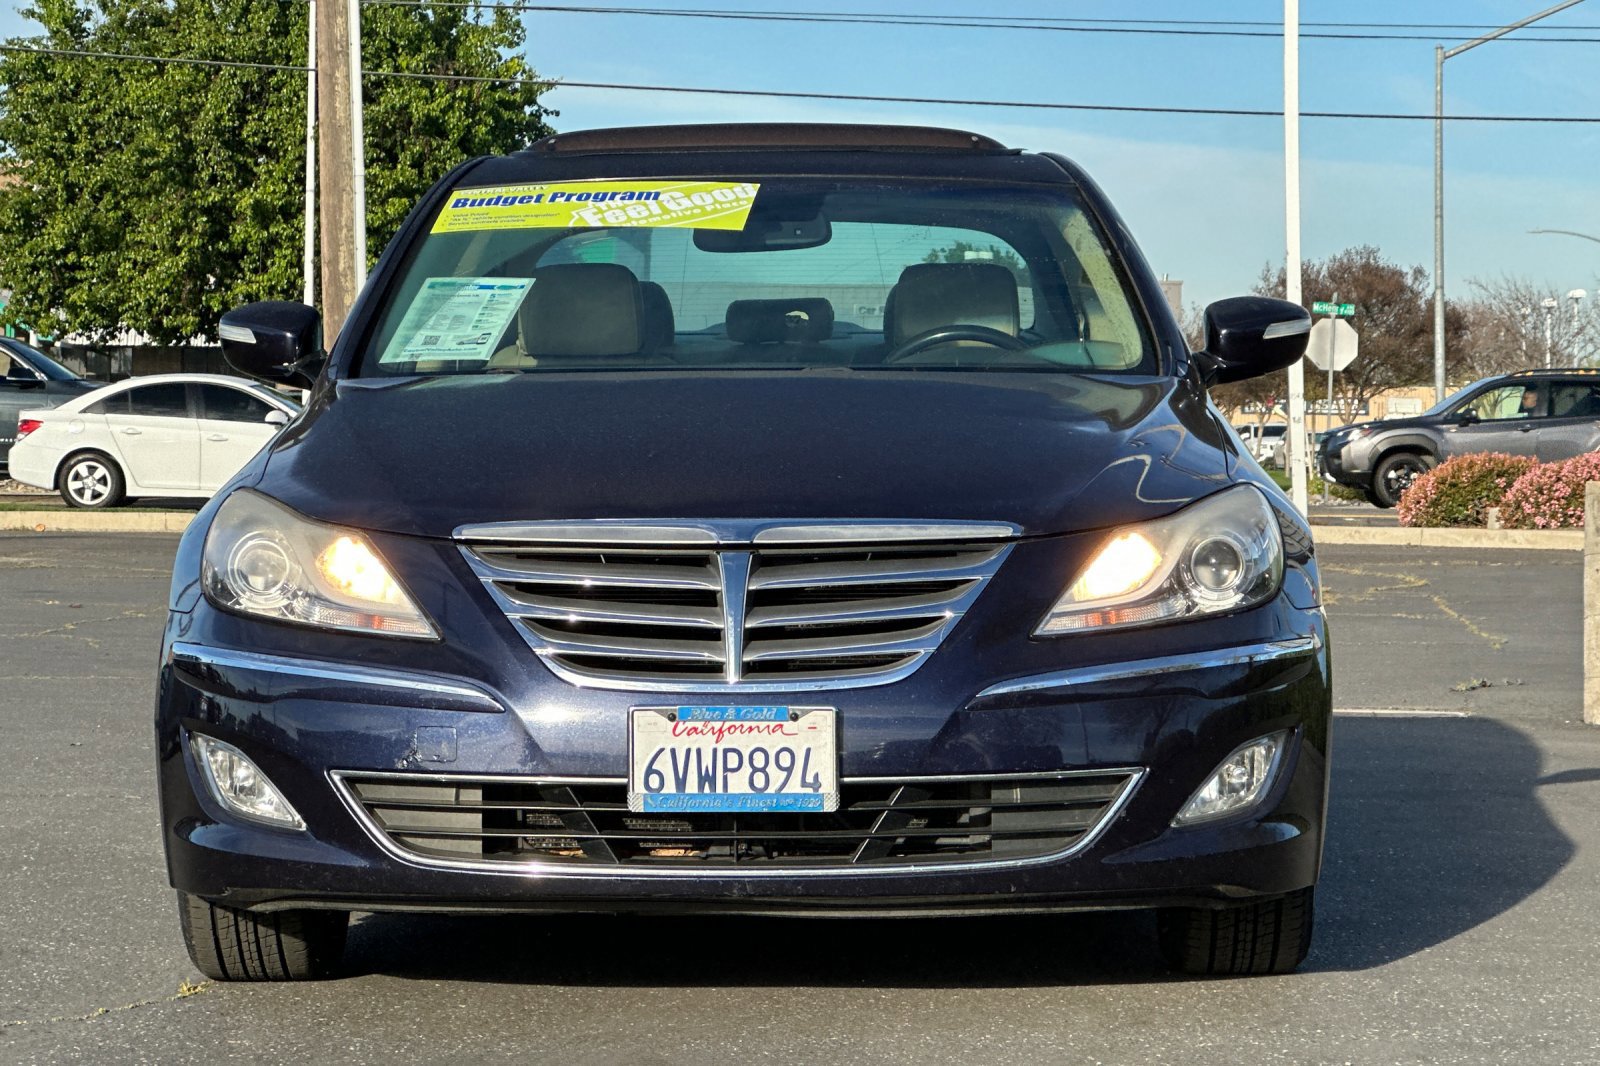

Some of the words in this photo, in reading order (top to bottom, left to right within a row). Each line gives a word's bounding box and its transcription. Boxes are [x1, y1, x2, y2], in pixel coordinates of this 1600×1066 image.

[451, 193, 546, 209] Budget
[548, 191, 661, 203] Program
[579, 198, 663, 227] Feel
[661, 183, 757, 212] Good
[703, 199, 748, 212] Place
[688, 707, 721, 720] Blue
[723, 707, 736, 719] &
[740, 707, 776, 720] Gold
[672, 720, 798, 744] California
[643, 747, 822, 794] 6VWP894
